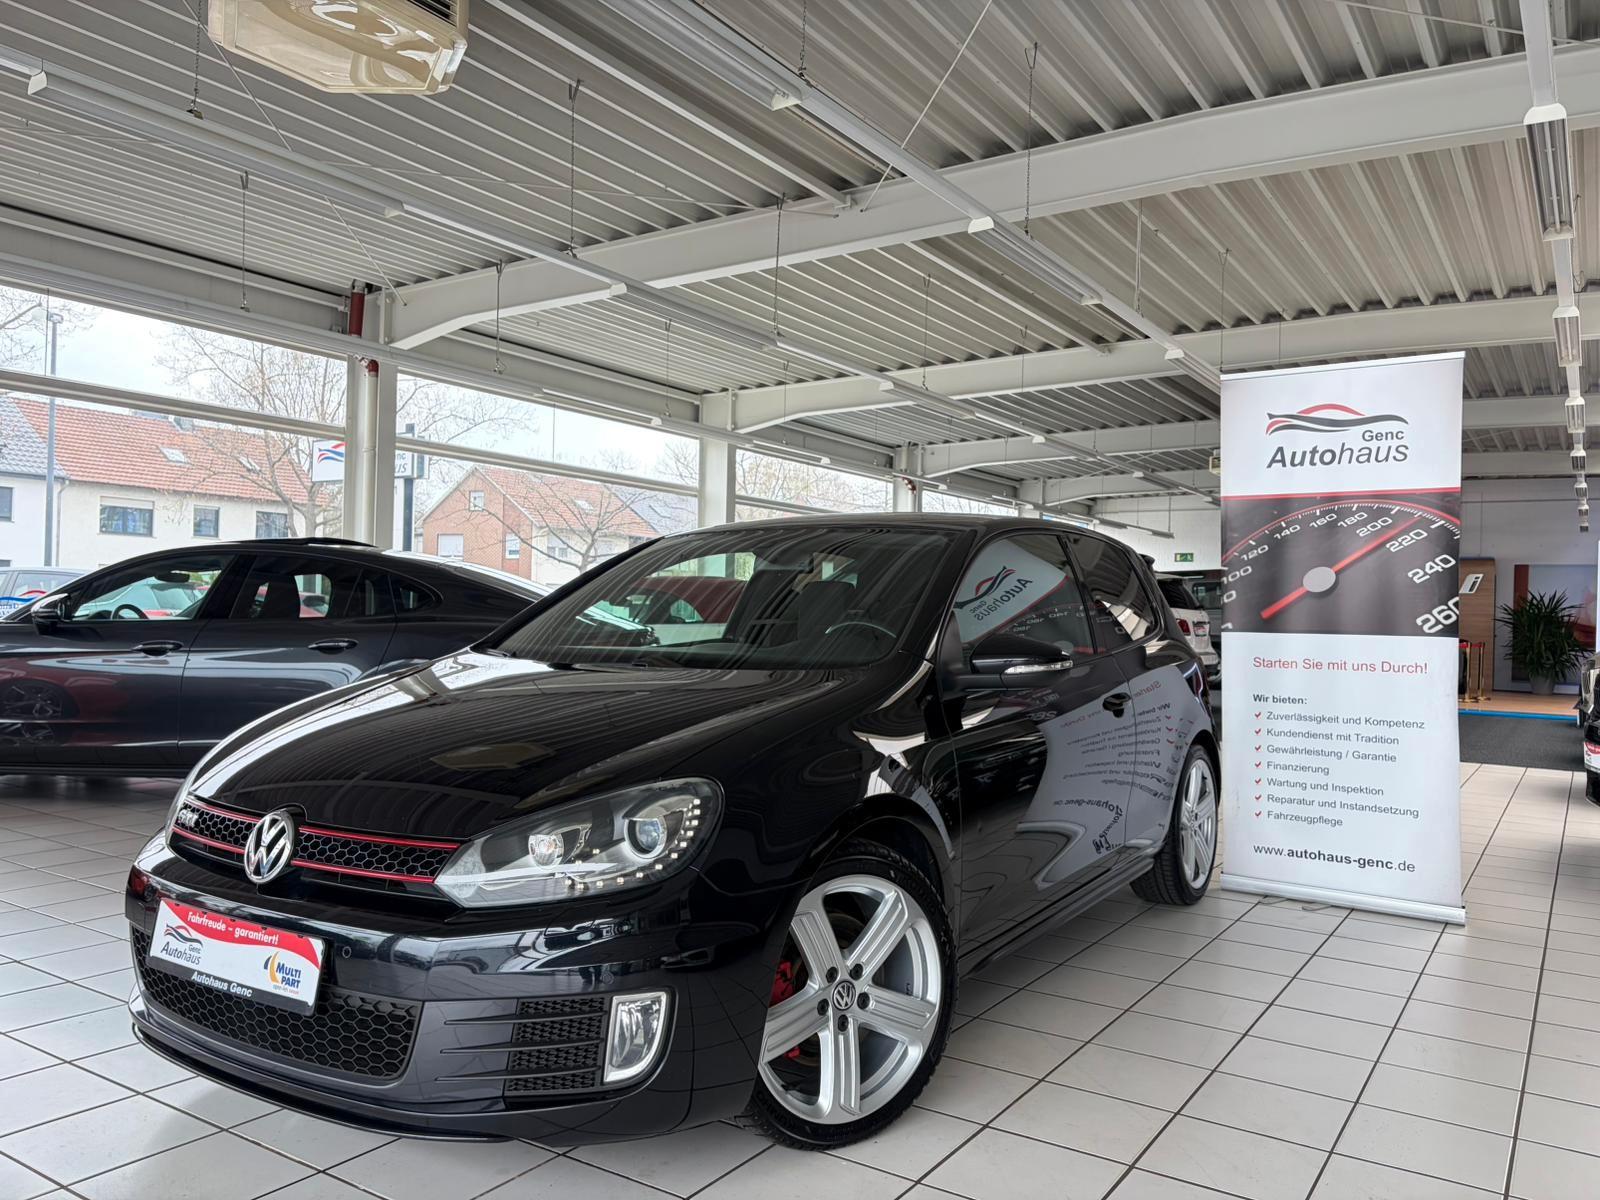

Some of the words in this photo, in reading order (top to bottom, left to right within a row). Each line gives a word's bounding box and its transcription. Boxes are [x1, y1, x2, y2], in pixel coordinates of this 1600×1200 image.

[1361, 429, 1405, 442] Genc
[1266, 442, 1410, 469] Autohaus
[1309, 513, 1338, 528] 160
[1337, 512, 1368, 528] 180
[1356, 517, 1393, 537] 200
[1274, 524, 1301, 540] 140
[1386, 529, 1428, 552] 220
[1241, 544, 1270, 561] 120
[1221, 565, 1253, 584] 100
[1407, 554, 1457, 584] 240
[1252, 656, 1298, 670] Starten
[1303, 658, 1323, 670] Sie
[1327, 660, 1347, 671] mit
[1352, 662, 1377, 672] uns
[1381, 661, 1428, 674] Durch!
[1253, 693, 1270, 703] Wir
[1272, 695, 1308, 705] bieten:
[1266, 711, 1340, 725] Zuverlässigkeit
[1342, 717, 1362, 726] und
[1365, 717, 1425, 729] Kompetenz
[1266, 728, 1334, 741] Kundendienst
[1336, 732, 1352, 742] mit
[1354, 733, 1400, 745] Tradition
[1266, 744, 1343, 761] Gewährleistung
[1345, 750, 1350, 759] /
[1352, 750, 1397, 762] Garantie
[1266, 760, 1330, 776] Finanzierung
[1266, 777, 1308, 791] Wartung
[1310, 782, 1329, 791] und
[1331, 783, 1384, 796] Inspektion
[1267, 793, 1316, 806] Reparatur
[1318, 799, 1337, 809] und
[1339, 800, 1420, 819] Instandsetzung
[1267, 810, 1343, 828] Fahrzeugpflege
[1253, 844, 1416, 873] www.autohaus-genc.de
[187, 911, 227, 931] Fahrfreude
[234, 927, 280, 946] garantiert!
[160, 941, 202, 966] Autohaus
[275, 961, 302, 979] MULTI
[190, 970, 229, 990] Autohaus
[229, 982, 254, 998] Genc
[280, 975, 301, 990] PART
